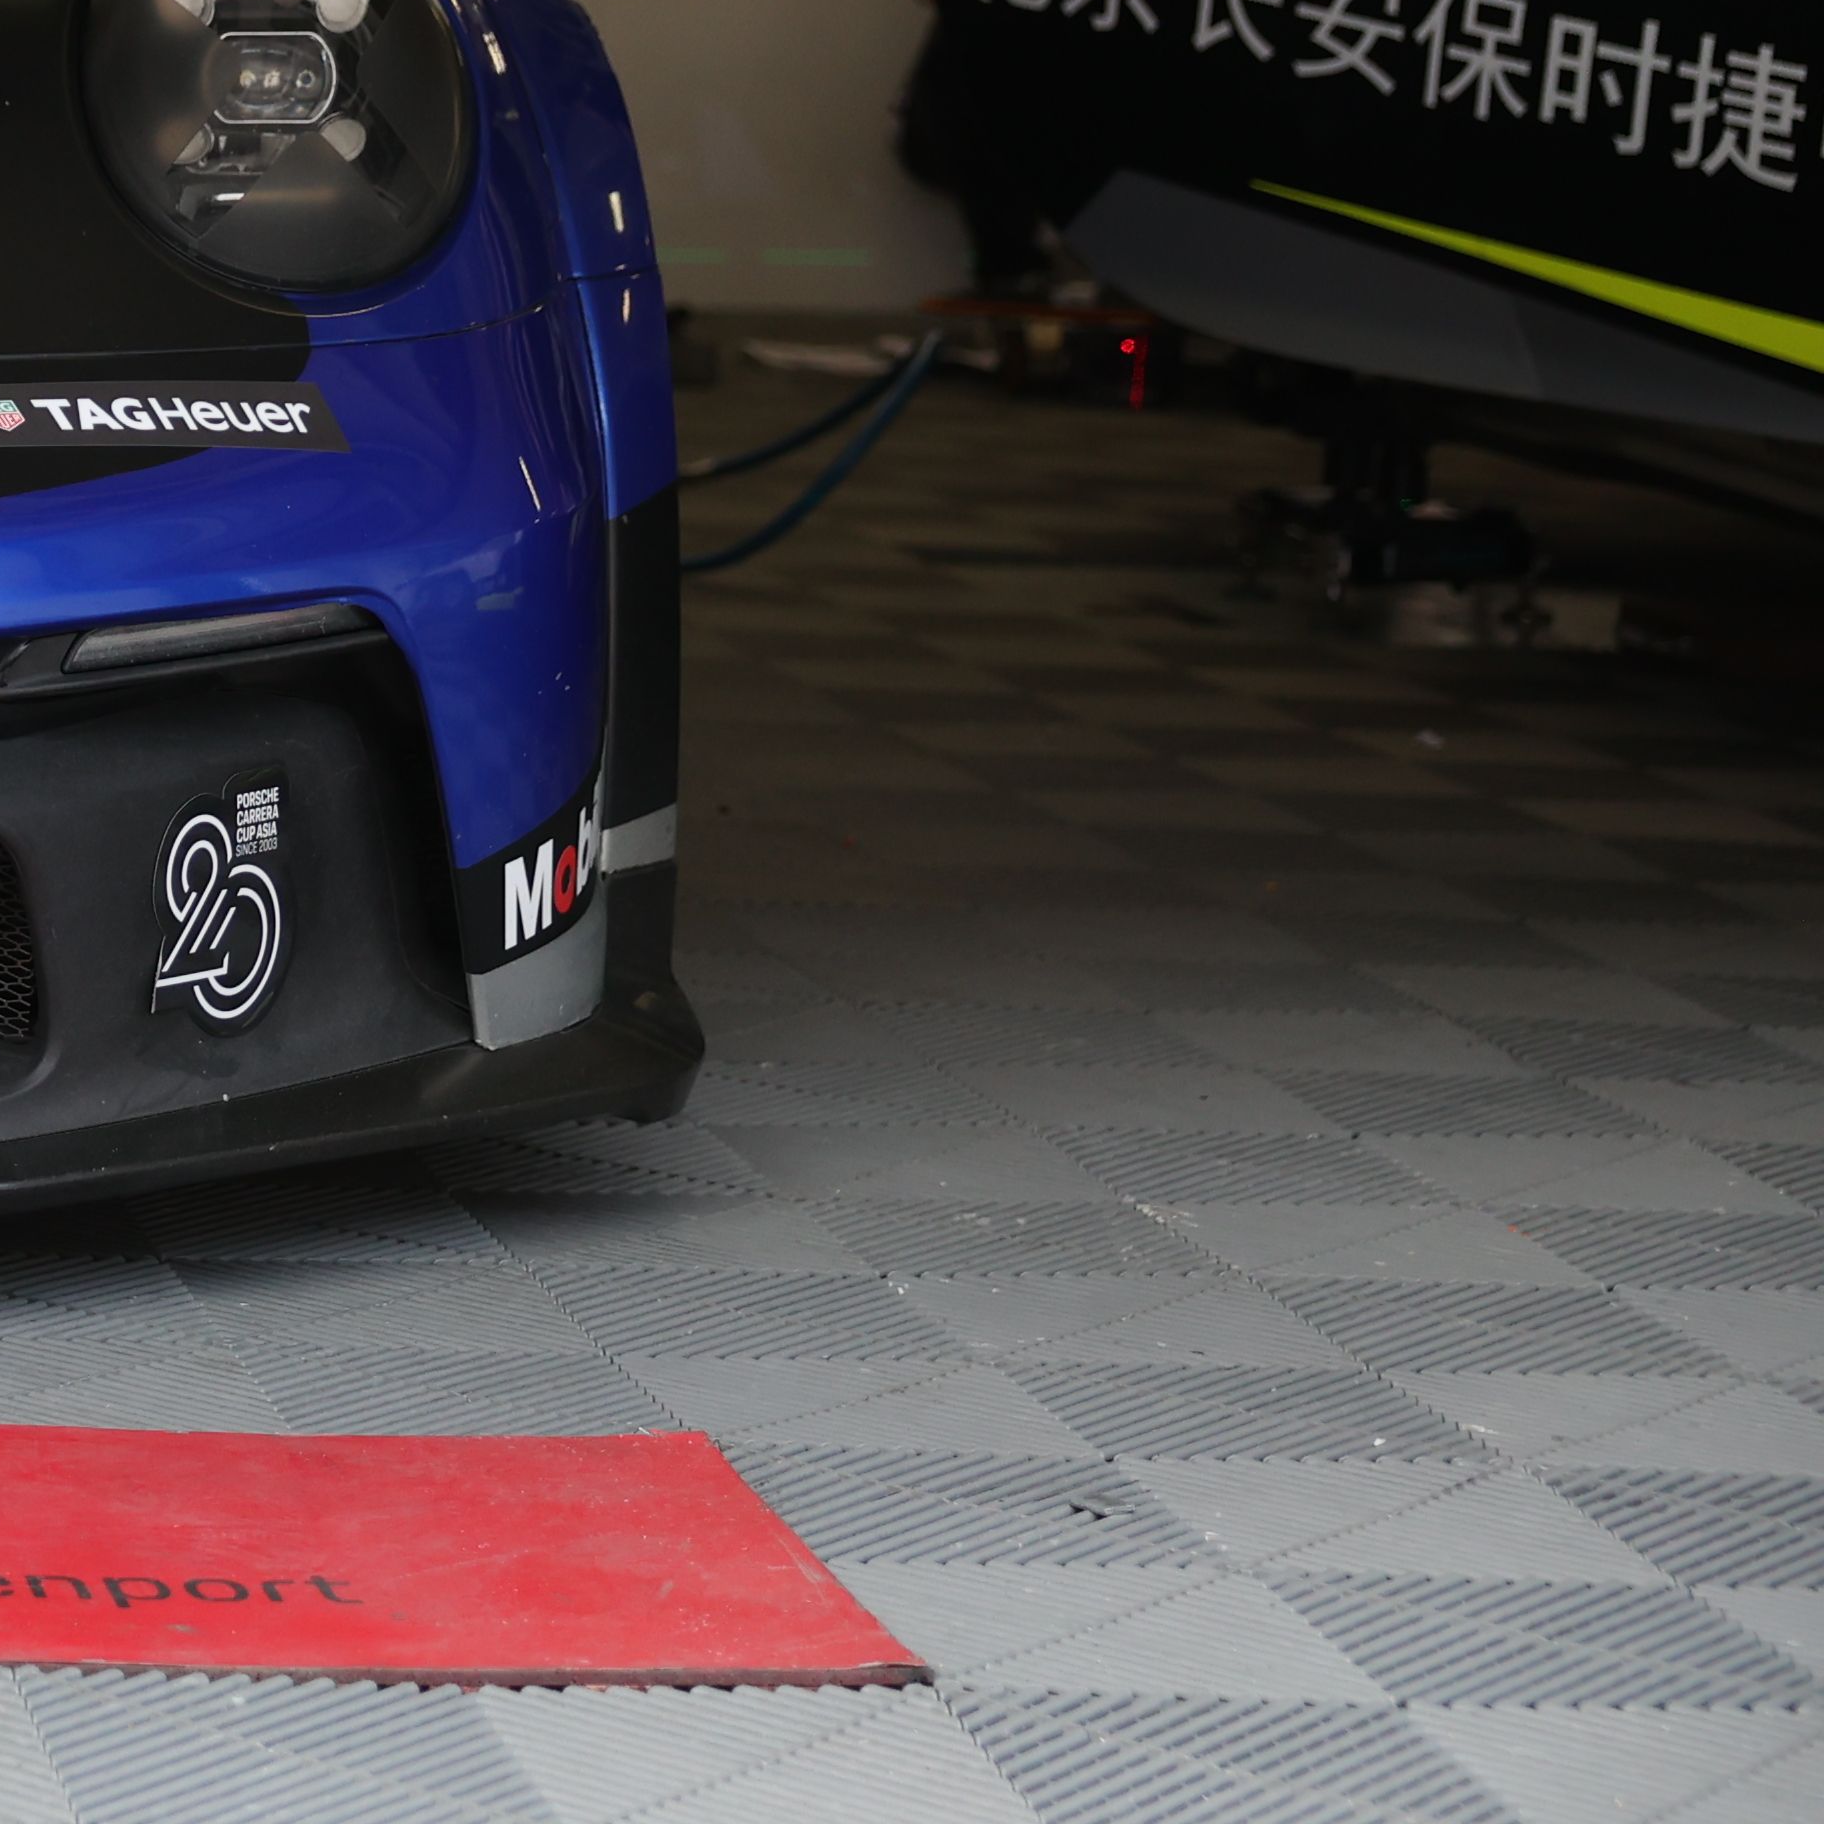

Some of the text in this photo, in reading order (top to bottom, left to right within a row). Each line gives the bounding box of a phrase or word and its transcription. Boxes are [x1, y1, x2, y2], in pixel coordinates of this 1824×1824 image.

[236, 786, 280, 810] PORSCHE
[236, 804, 280, 827] CARRERA
[236, 820, 278, 844] CUP ASIA
[235, 836, 279, 858] SINCE 2003
